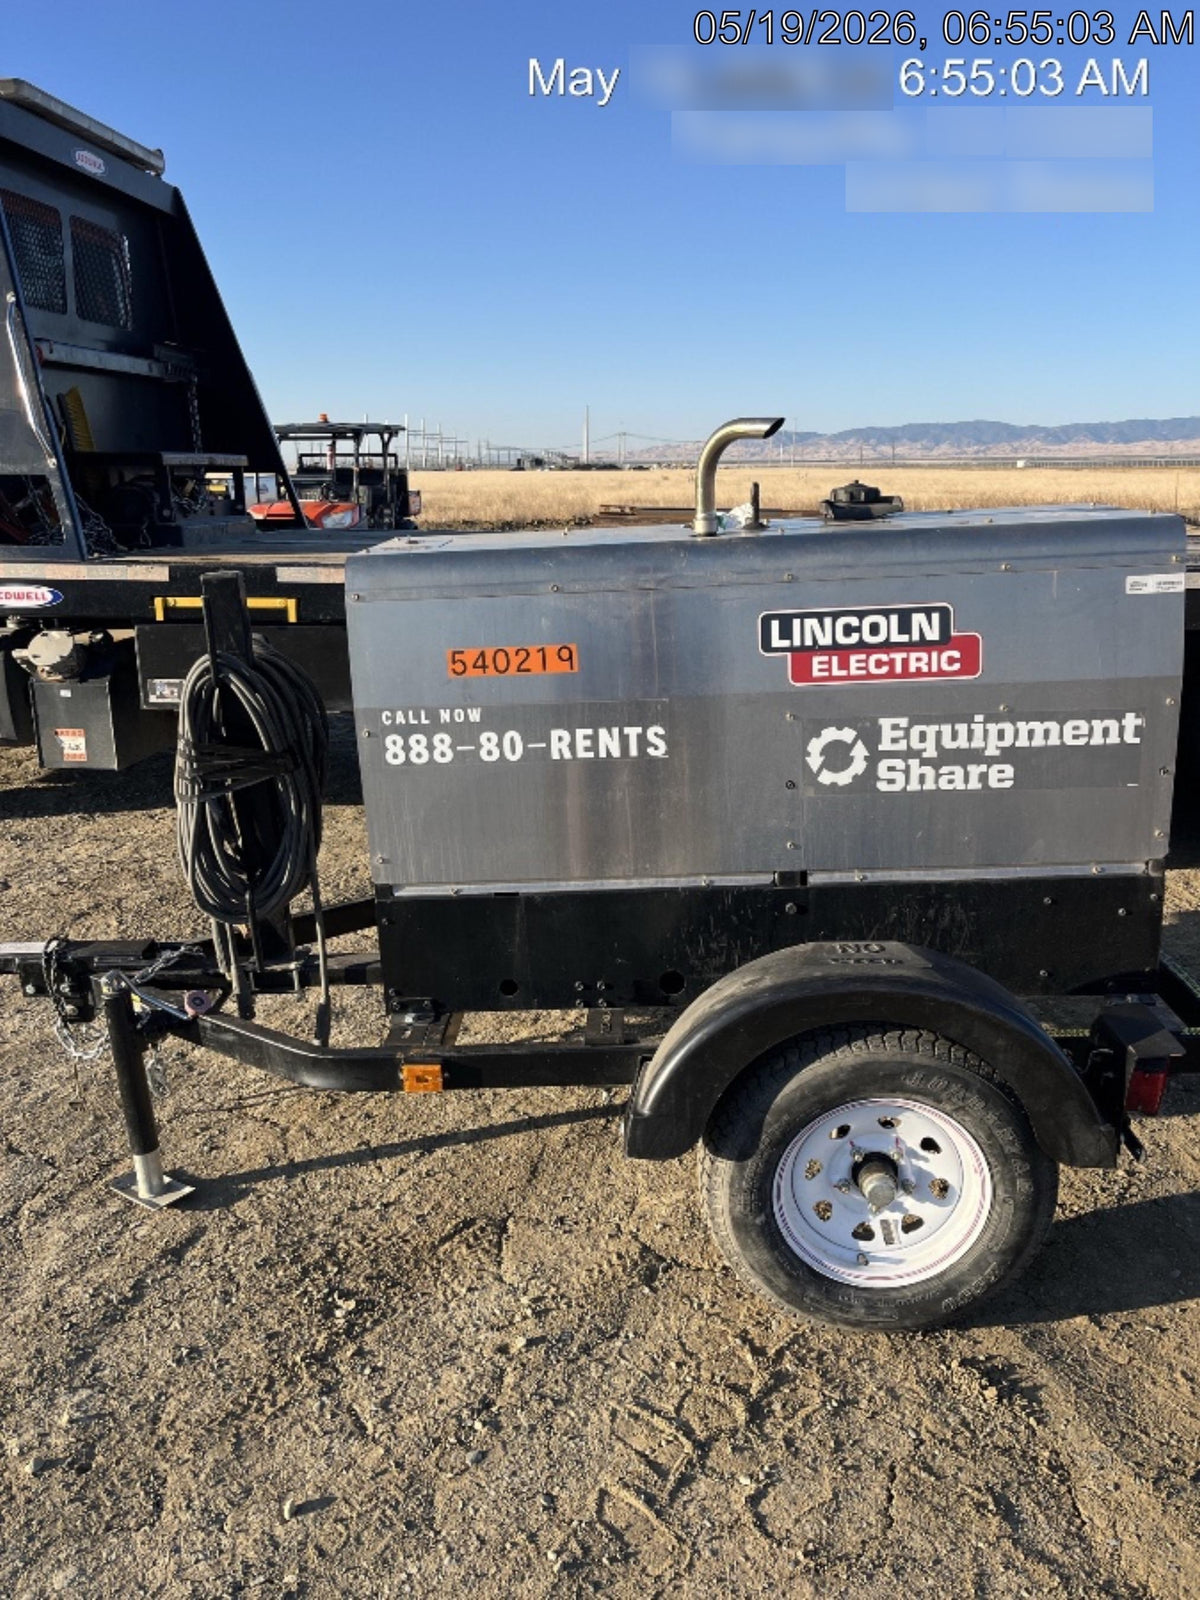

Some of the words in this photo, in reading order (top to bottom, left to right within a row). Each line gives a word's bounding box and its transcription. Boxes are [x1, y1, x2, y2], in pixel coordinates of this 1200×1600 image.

[770, 612, 941, 648] LINCOLN
[450, 645, 575, 676] 540219
[811, 649, 962, 677] ELECTRIC
[381, 709, 431, 725] CALL
[440, 707, 483, 724] NOW
[384, 724, 669, 765] 888-80-RENTS
[877, 712, 1142, 758] Equipment
[876, 758, 1015, 792] Share
